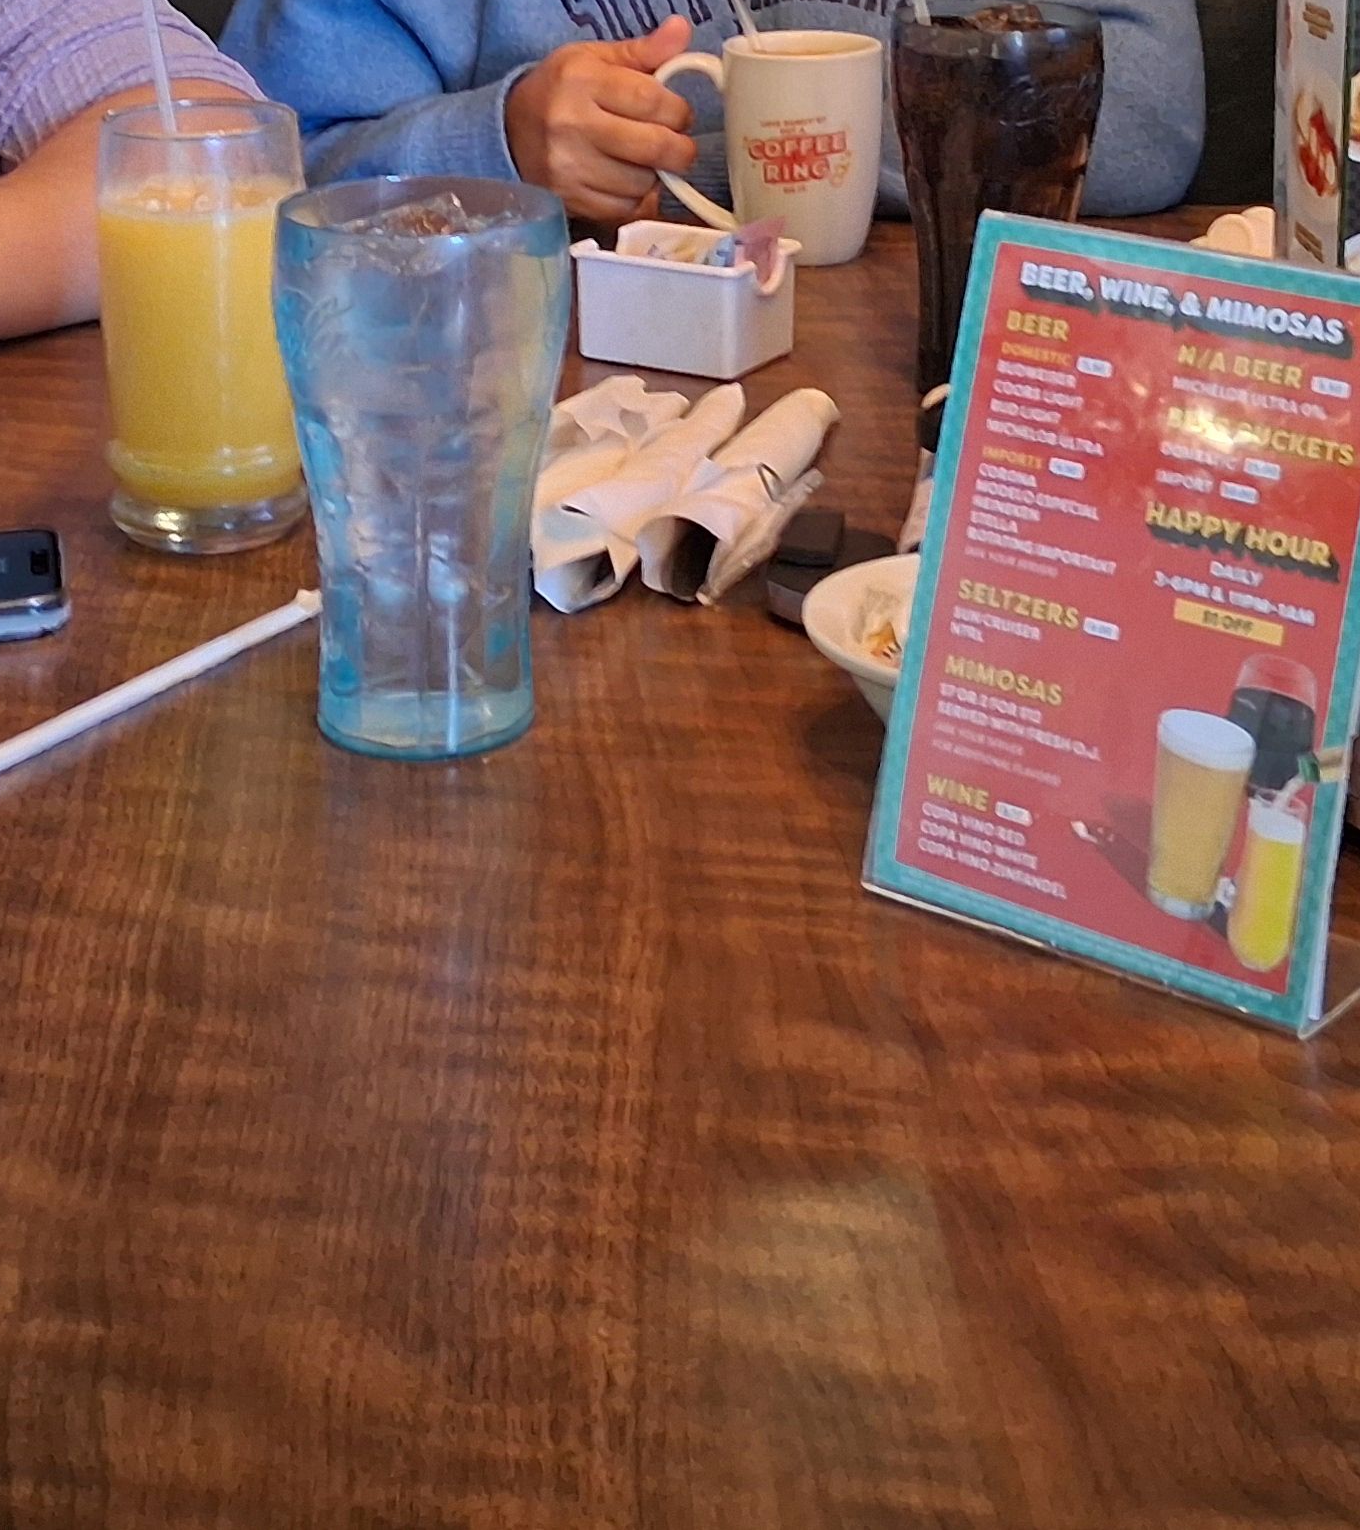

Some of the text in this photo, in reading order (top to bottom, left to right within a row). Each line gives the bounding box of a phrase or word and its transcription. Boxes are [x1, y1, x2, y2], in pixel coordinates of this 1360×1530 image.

[748, 131, 847, 160] COFFEE
[763, 157, 830, 183] RING
[1020, 262, 1346, 344] BEER, WINE, & MIMOSAS
[1007, 311, 1069, 340] BEER
[1177, 345, 1226, 372] N/A
[1233, 356, 1303, 388] BEER
[979, 464, 1037, 487] CORONA
[1145, 502, 1333, 568] HAPPY HOUR
[1210, 562, 1262, 587] DAILY
[958, 579, 1080, 628] SELTZERS
[945, 655, 1064, 706] MIMOSAS
[926, 774, 990, 811] WINE
